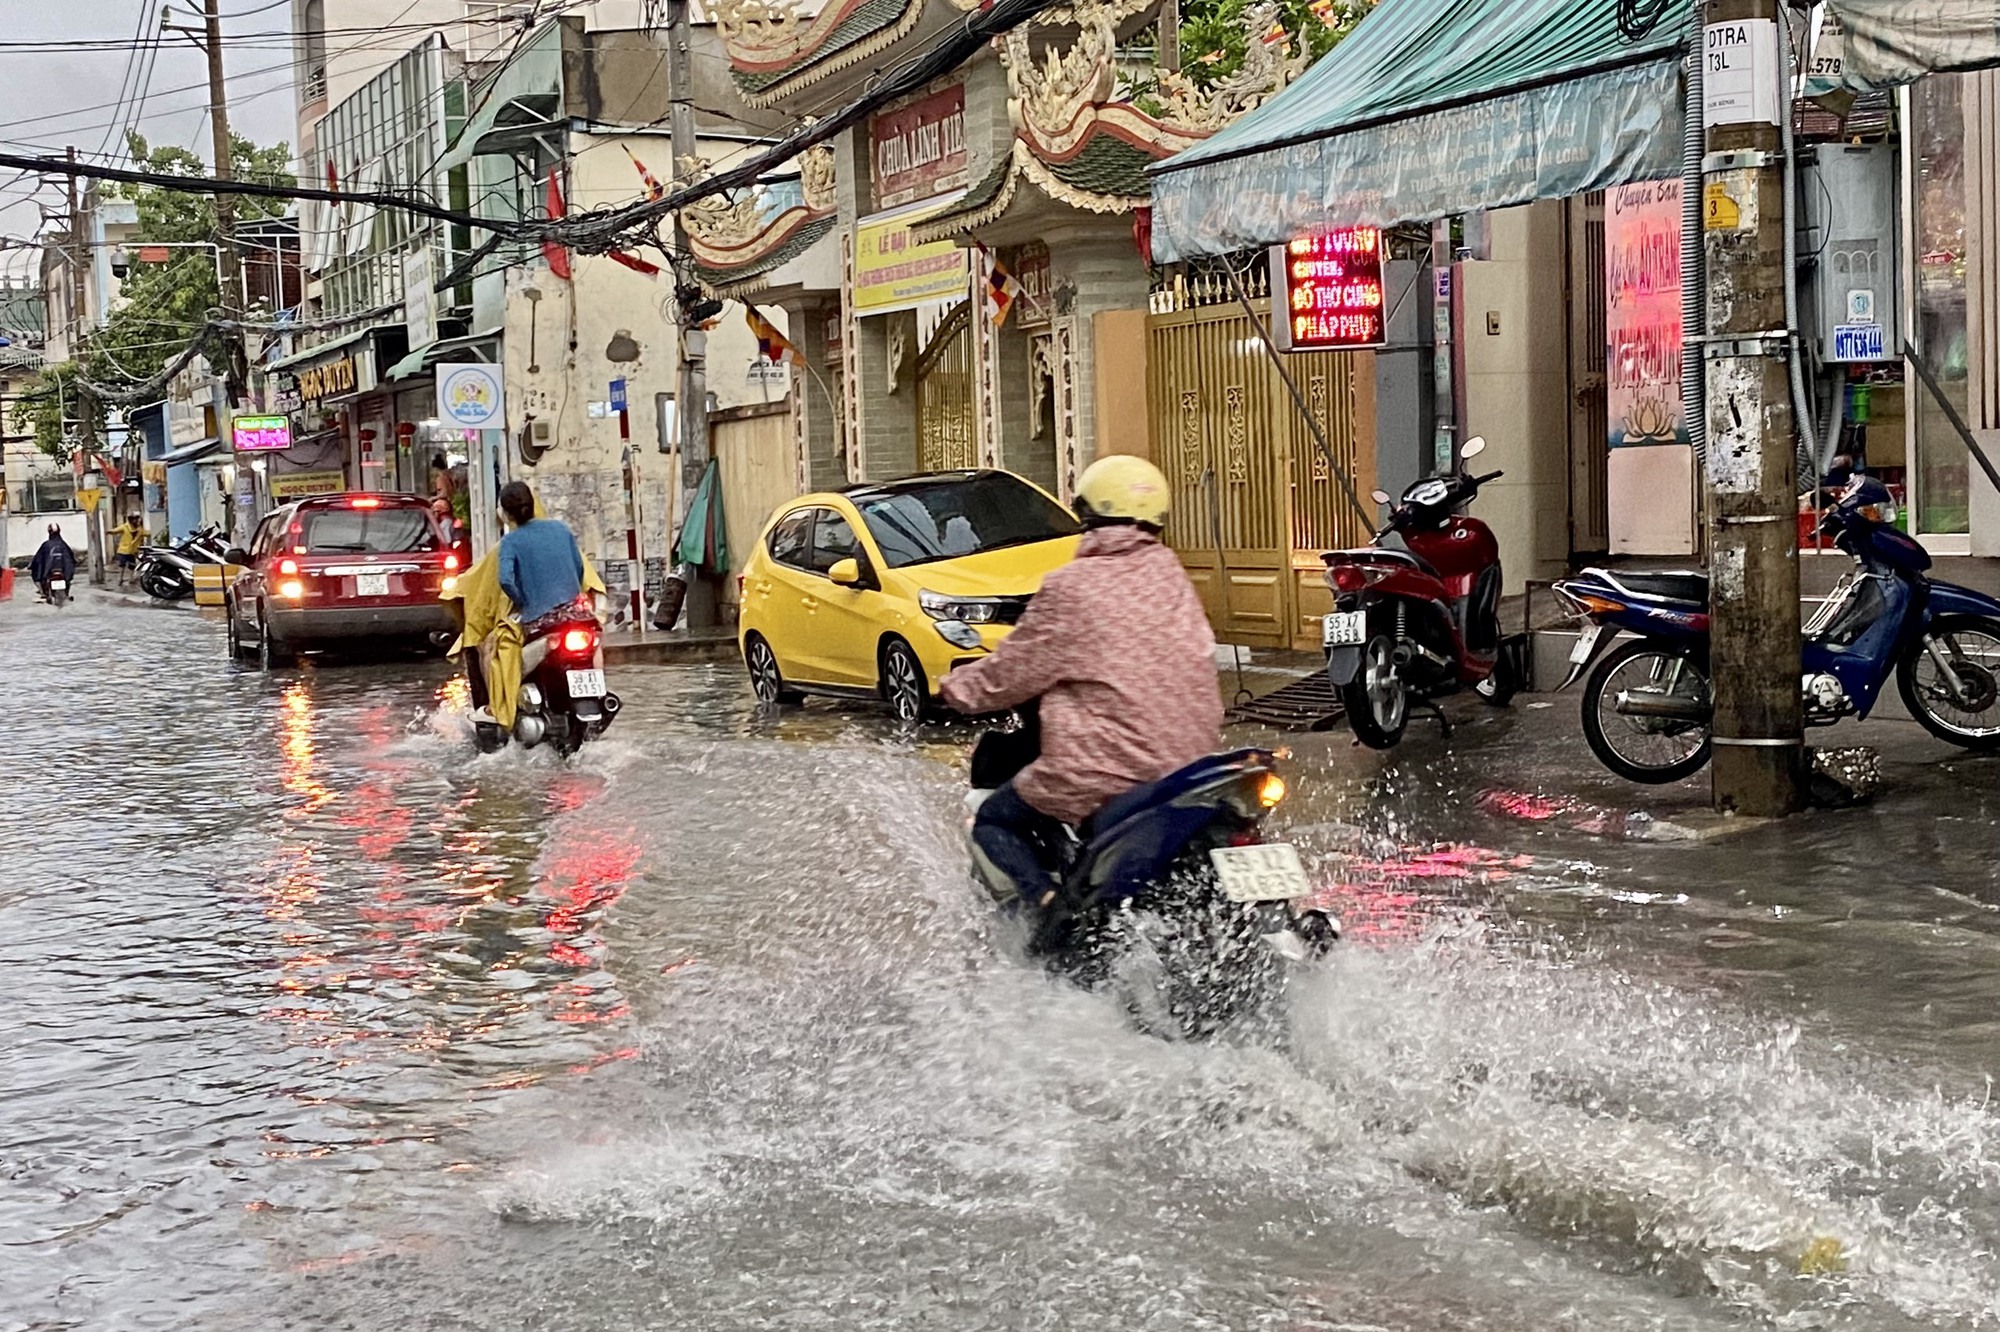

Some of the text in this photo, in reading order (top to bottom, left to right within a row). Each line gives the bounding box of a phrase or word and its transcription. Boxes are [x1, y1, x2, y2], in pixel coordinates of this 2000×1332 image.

[1708, 26, 1747, 48] DTRA
[1708, 51, 1730, 71] T3L
[878, 124, 911, 178] CHÙA
[1710, 200, 1718, 217] 3
[1296, 309, 1378, 341] PHÁP PHỤC
